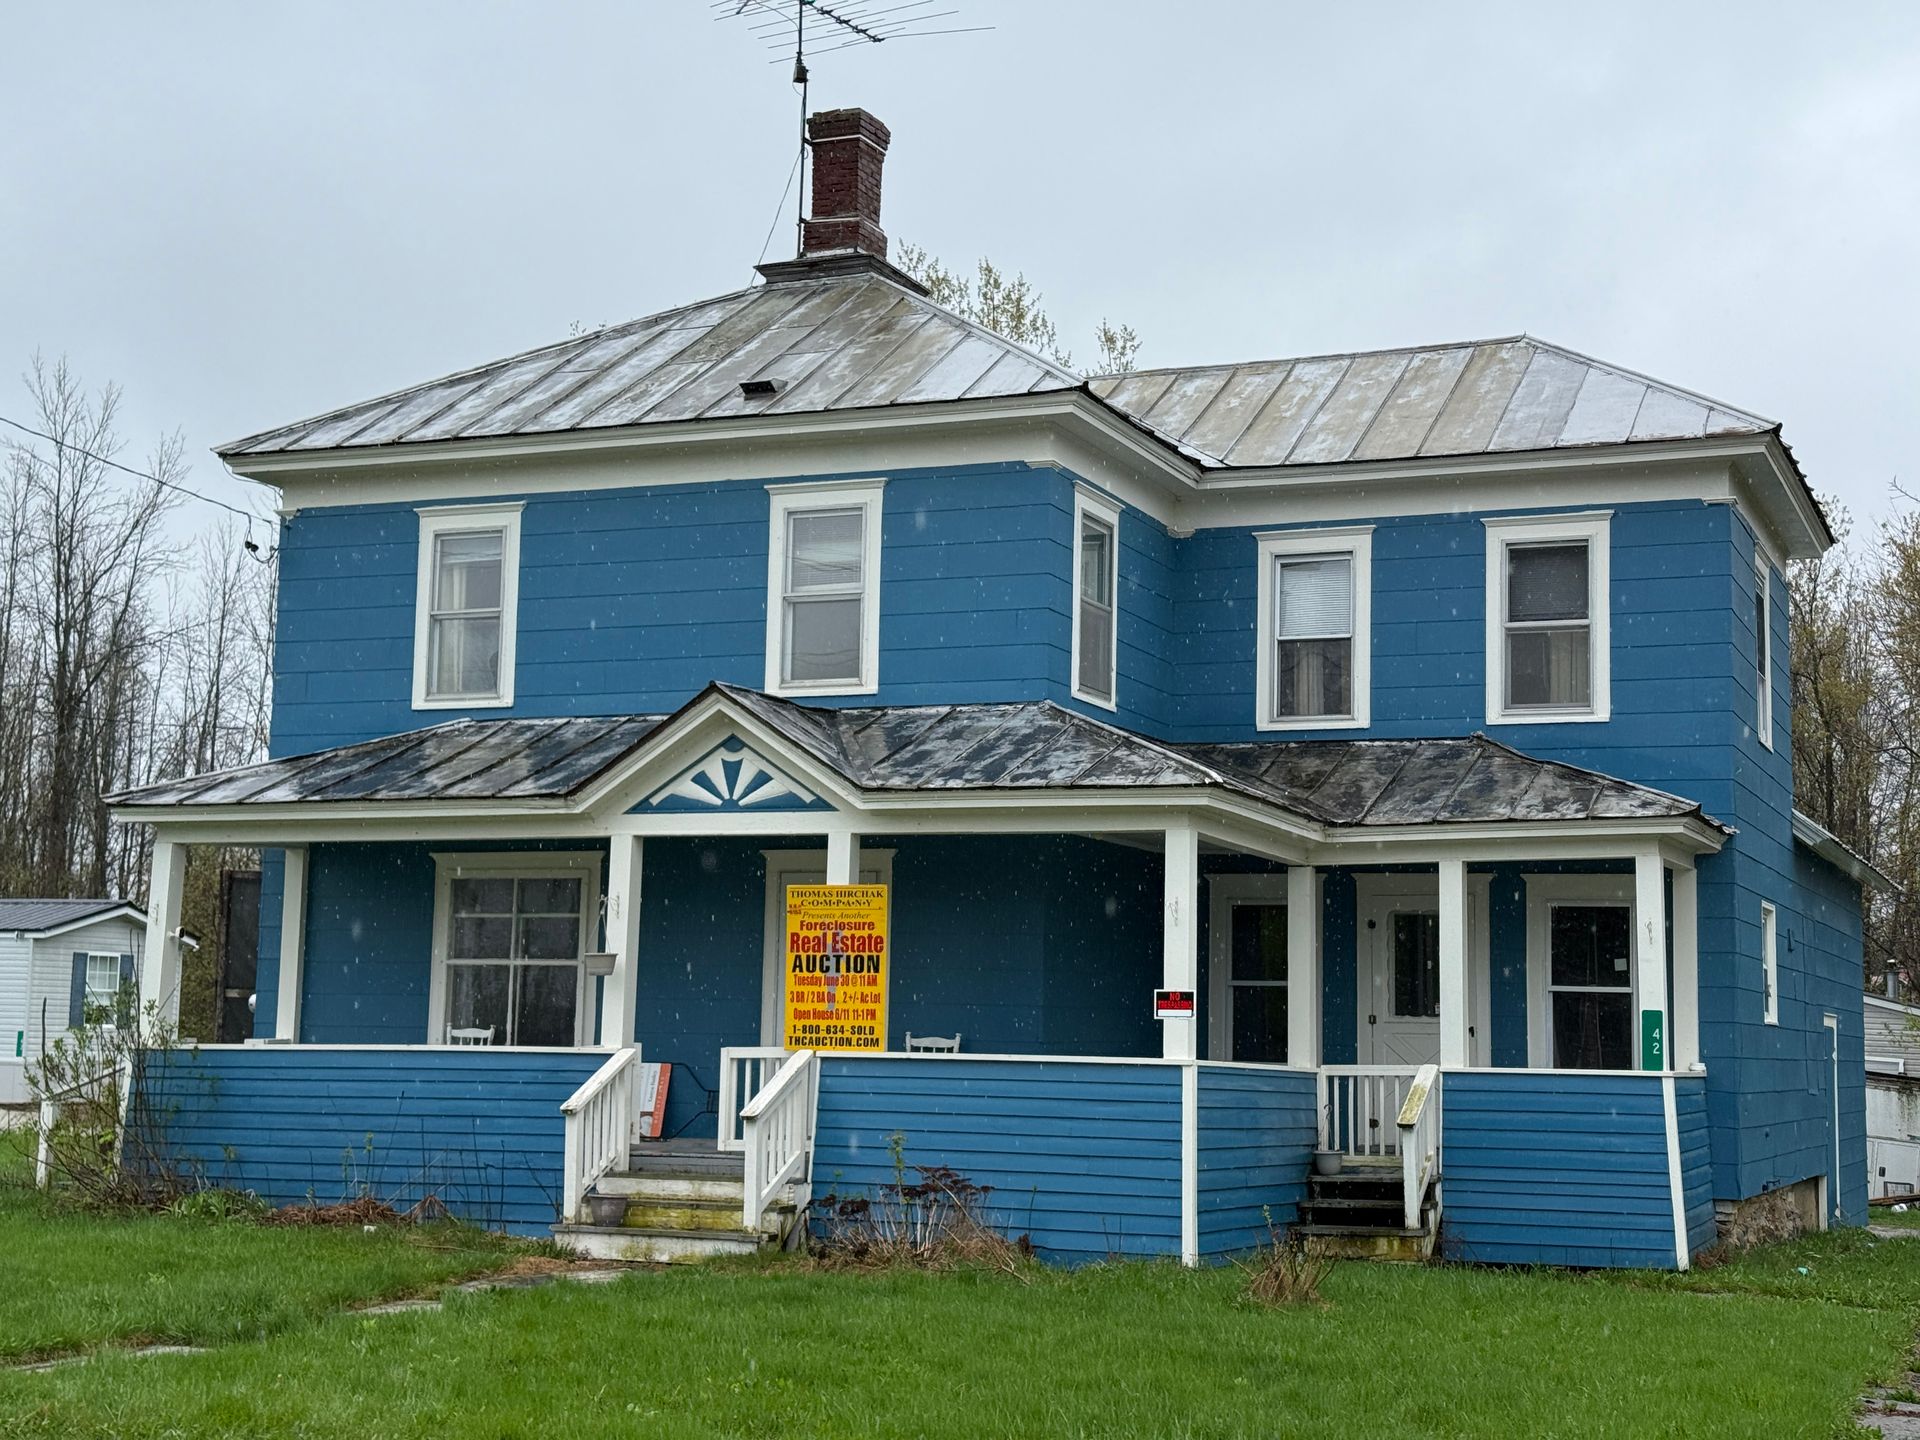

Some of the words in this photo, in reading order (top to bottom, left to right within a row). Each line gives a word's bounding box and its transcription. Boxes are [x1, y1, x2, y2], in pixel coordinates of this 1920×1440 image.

[790, 890, 833, 898] THOMAS
[835, 890, 884, 898] HIRCHAK
[802, 911, 835, 919] Presents
[837, 911, 871, 919] Another
[799, 920, 875, 931] Foreclosure
[790, 932, 828, 953] Real
[831, 932, 884, 953] Estate
[791, 954, 880, 974] AUCTION
[793, 974, 823, 987] Tuesday
[823, 974, 839, 987] June
[840, 975, 850, 987] 30
[851, 975, 858, 987] @
[859, 975, 866, 987] 11
[866, 975, 878, 987] AM
[790, 991, 795, 1003] 3
[795, 991, 805, 1003] BR
[810, 991, 815, 1003] 2
[816, 991, 826, 1003] BA
[860, 992, 869, 1004] Ac
[870, 992, 881, 1004] Lot
[1169, 992, 1181, 1000] NO
[793, 1007, 811, 1021] Open
[812, 1008, 834, 1021] House
[866, 1008, 876, 1021] PM
[792, 1024, 875, 1036] 1-800-634-SOLD
[789, 1035, 880, 1048] THCAUCTION.COM
[1652, 1028, 1660, 1055] 42
